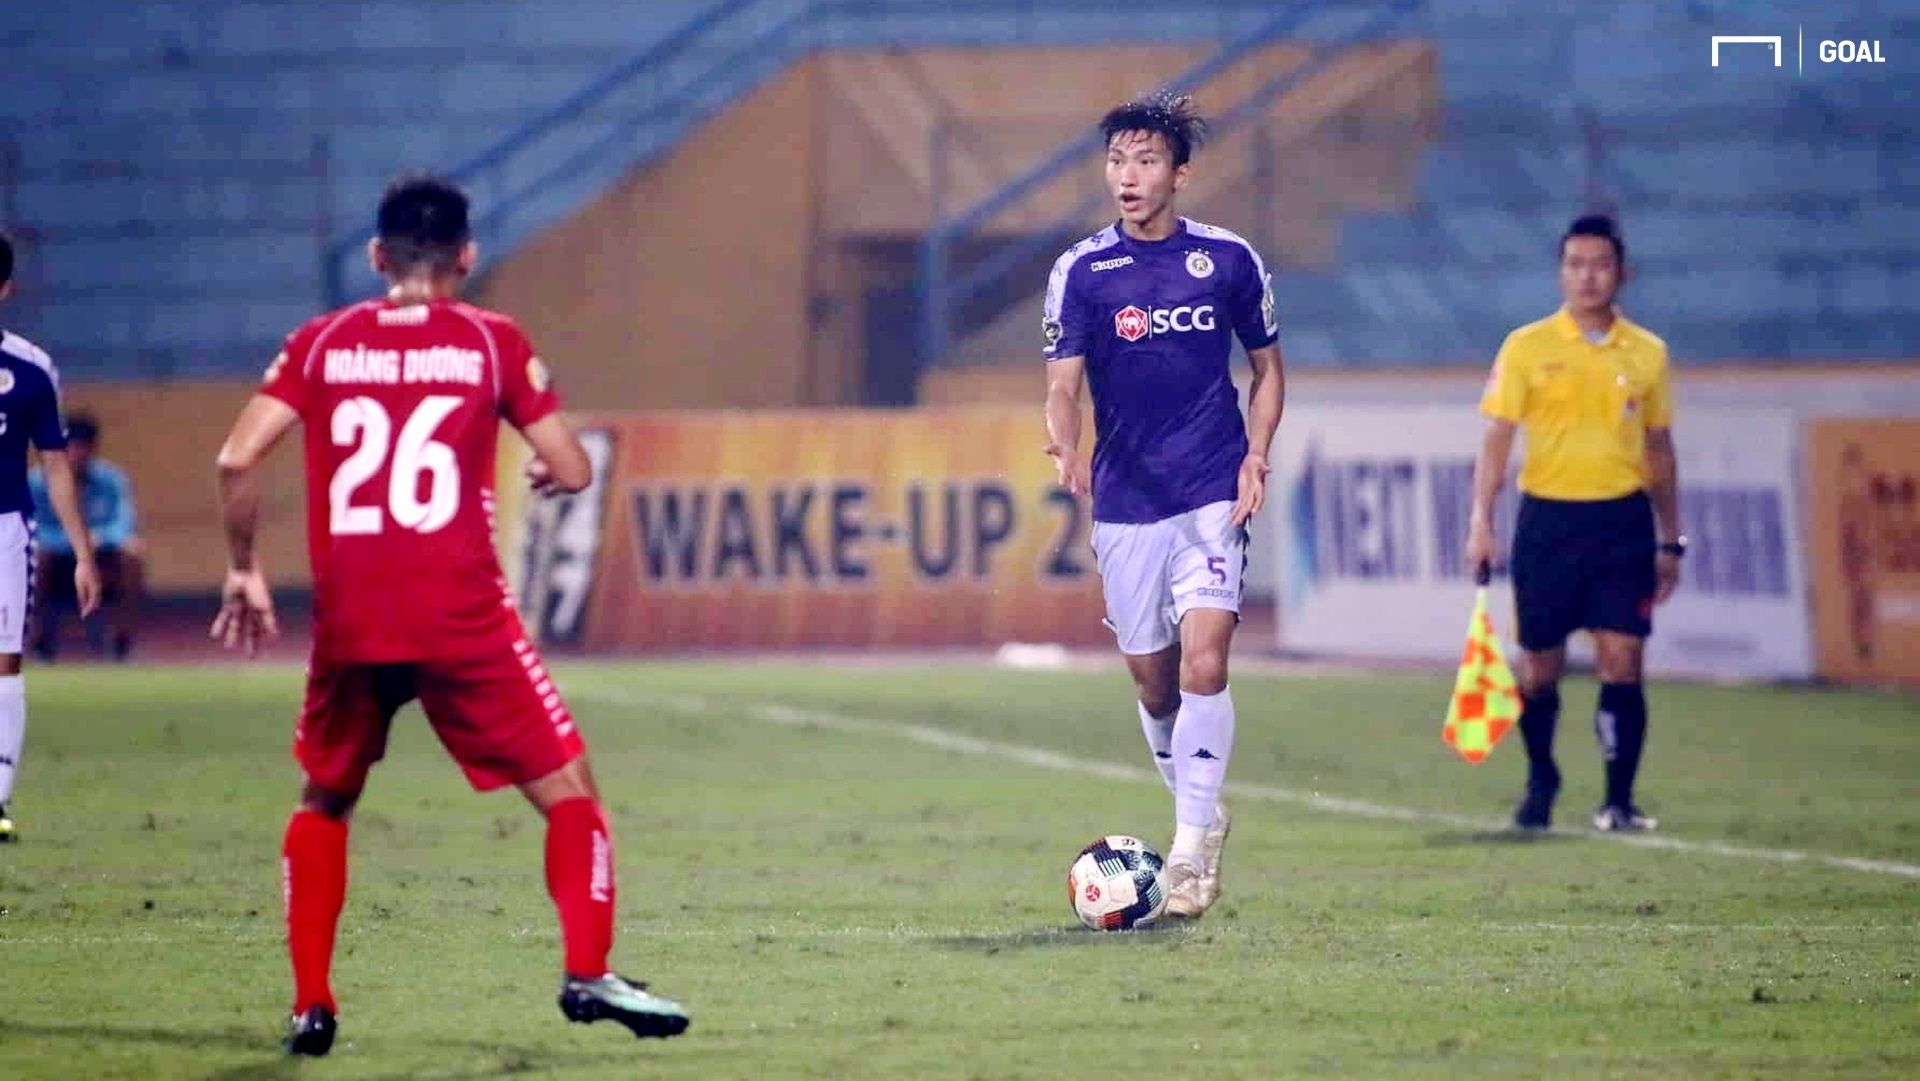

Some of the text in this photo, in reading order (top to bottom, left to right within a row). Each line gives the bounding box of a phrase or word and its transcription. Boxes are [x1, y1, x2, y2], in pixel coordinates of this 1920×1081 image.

[1152, 305, 1215, 333] SCG
[329, 395, 465, 535] 26
[630, 482, 1017, 582] WAKE-UP
[1207, 556, 1227, 587] 5
